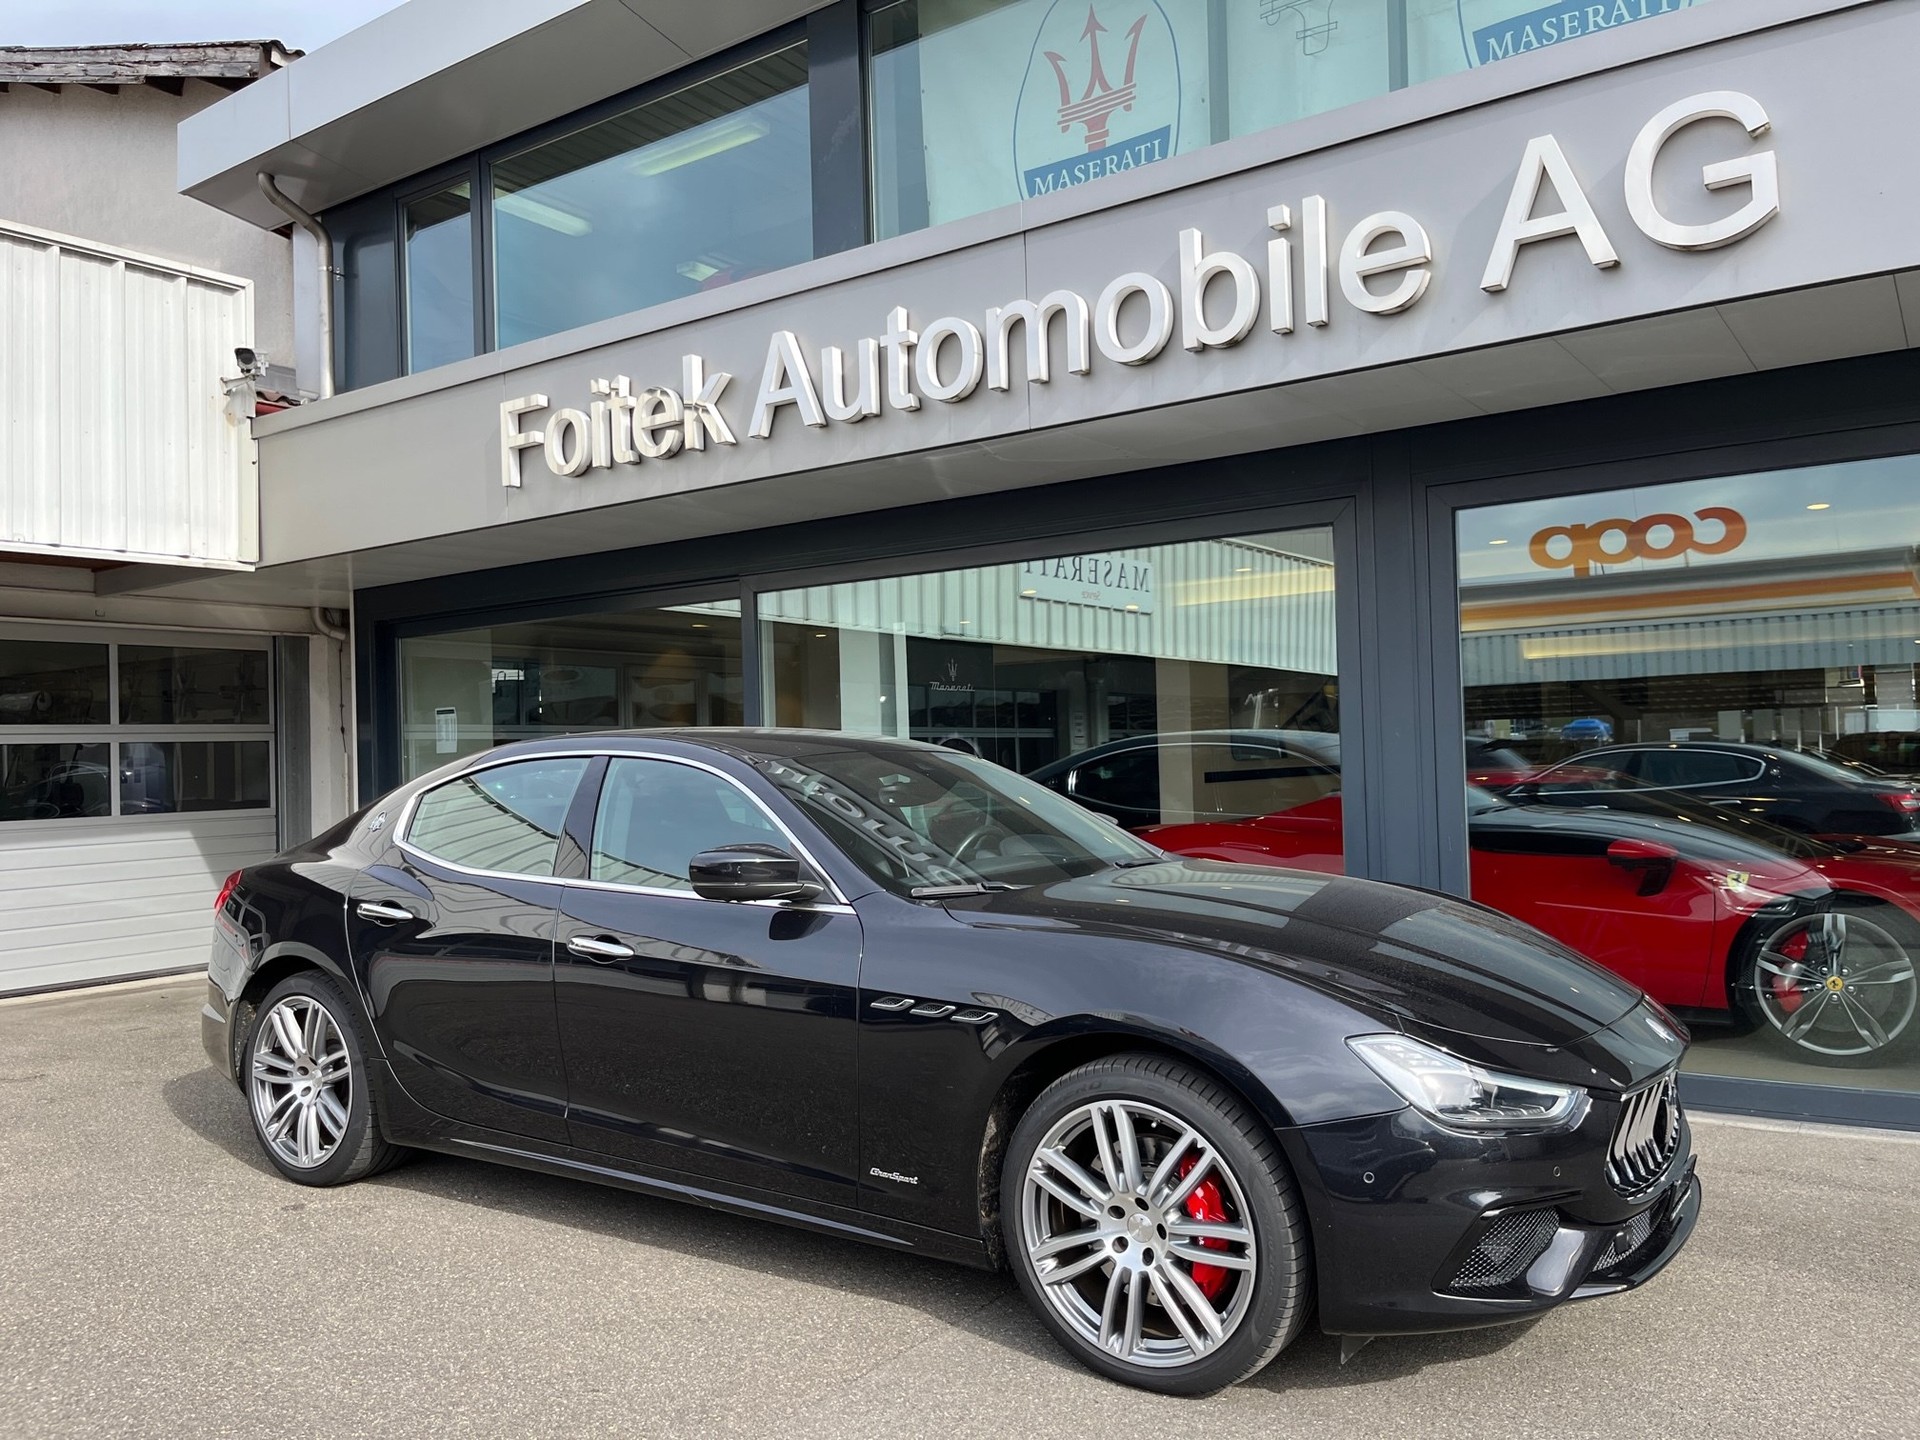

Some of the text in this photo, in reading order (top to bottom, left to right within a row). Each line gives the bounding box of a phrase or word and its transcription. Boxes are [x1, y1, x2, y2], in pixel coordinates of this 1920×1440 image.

[1033, 139, 1163, 198] MASERATI
[500, 90, 1780, 488] Foitek Automobile AG
[869, 1167, 919, 1185] GranSport
